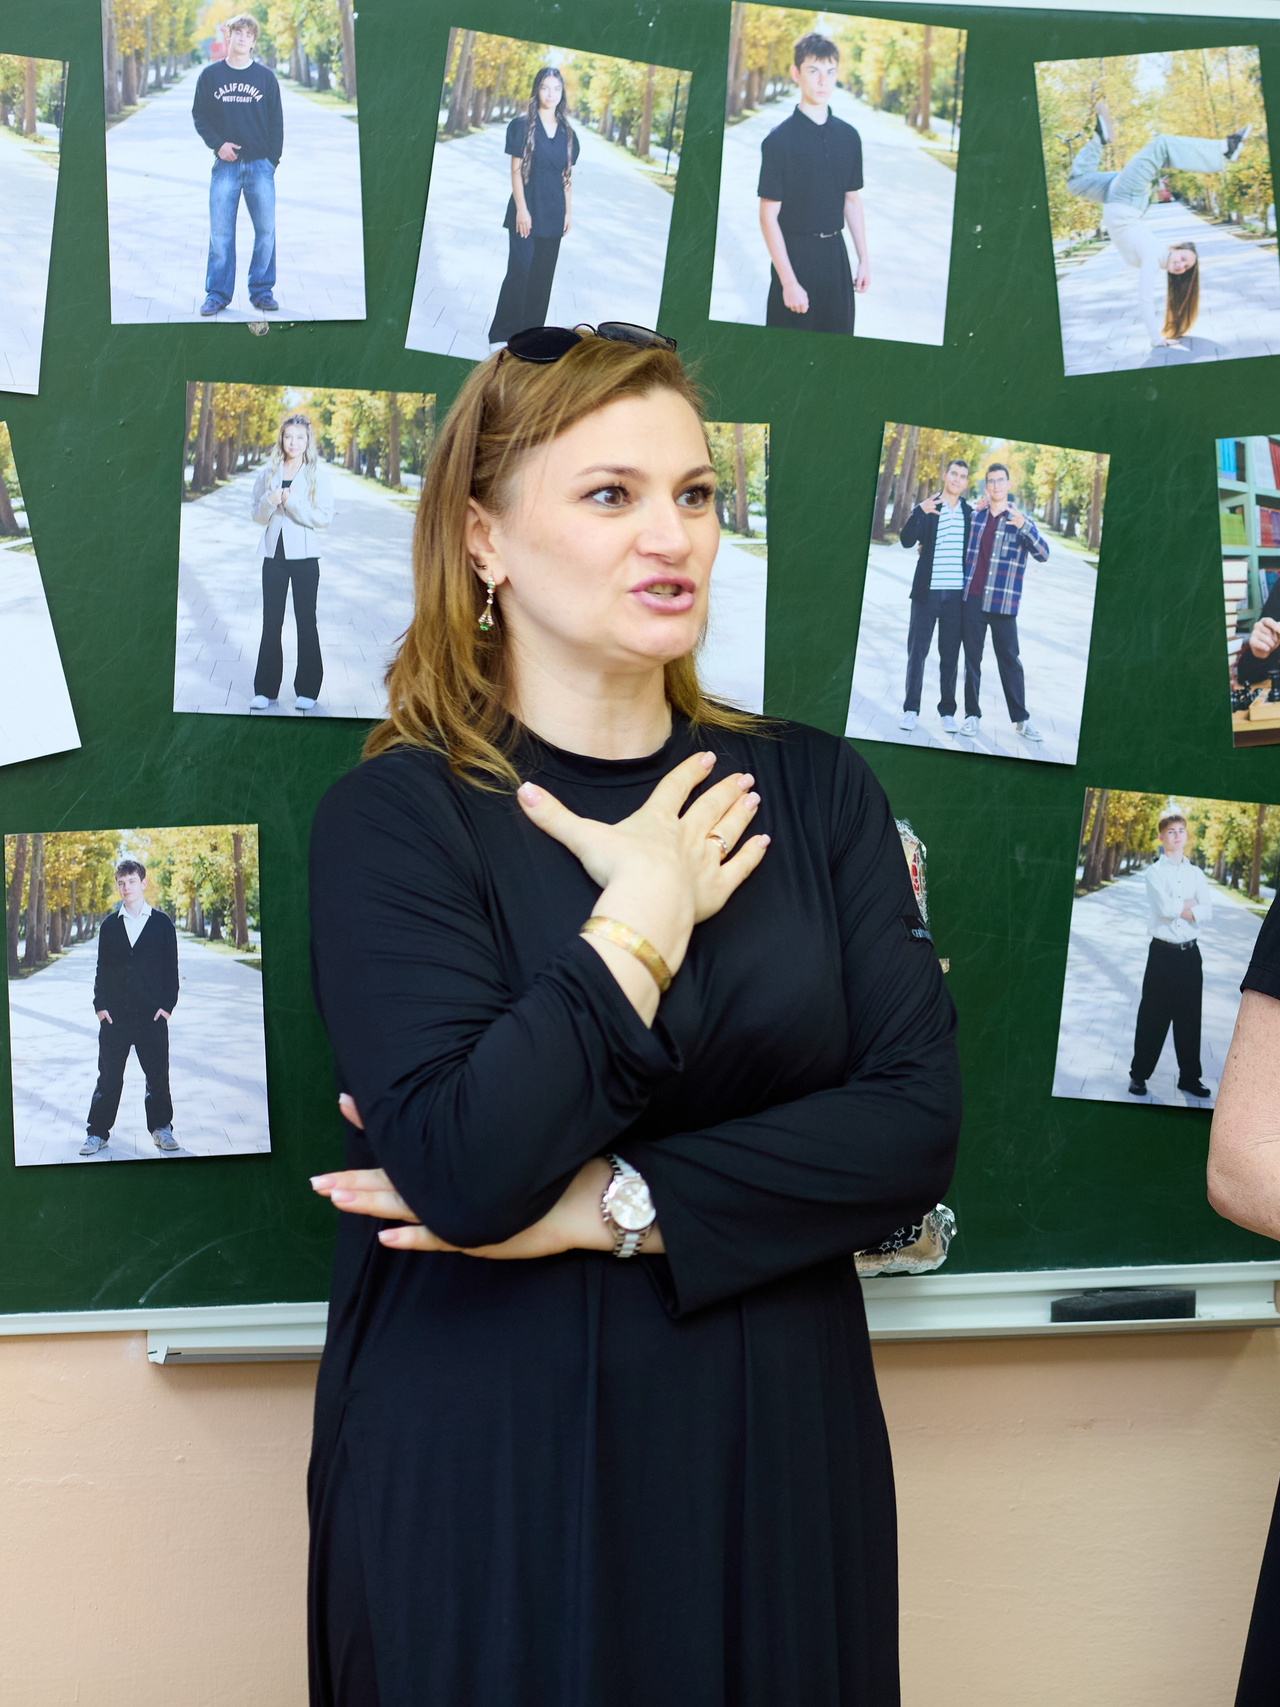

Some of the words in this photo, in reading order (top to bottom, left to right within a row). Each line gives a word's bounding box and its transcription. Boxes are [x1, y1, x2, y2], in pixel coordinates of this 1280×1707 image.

[213, 82, 263, 102] CALIFORNIA
[222, 95, 236, 103] WEST
[236, 95, 252, 103] COAST
